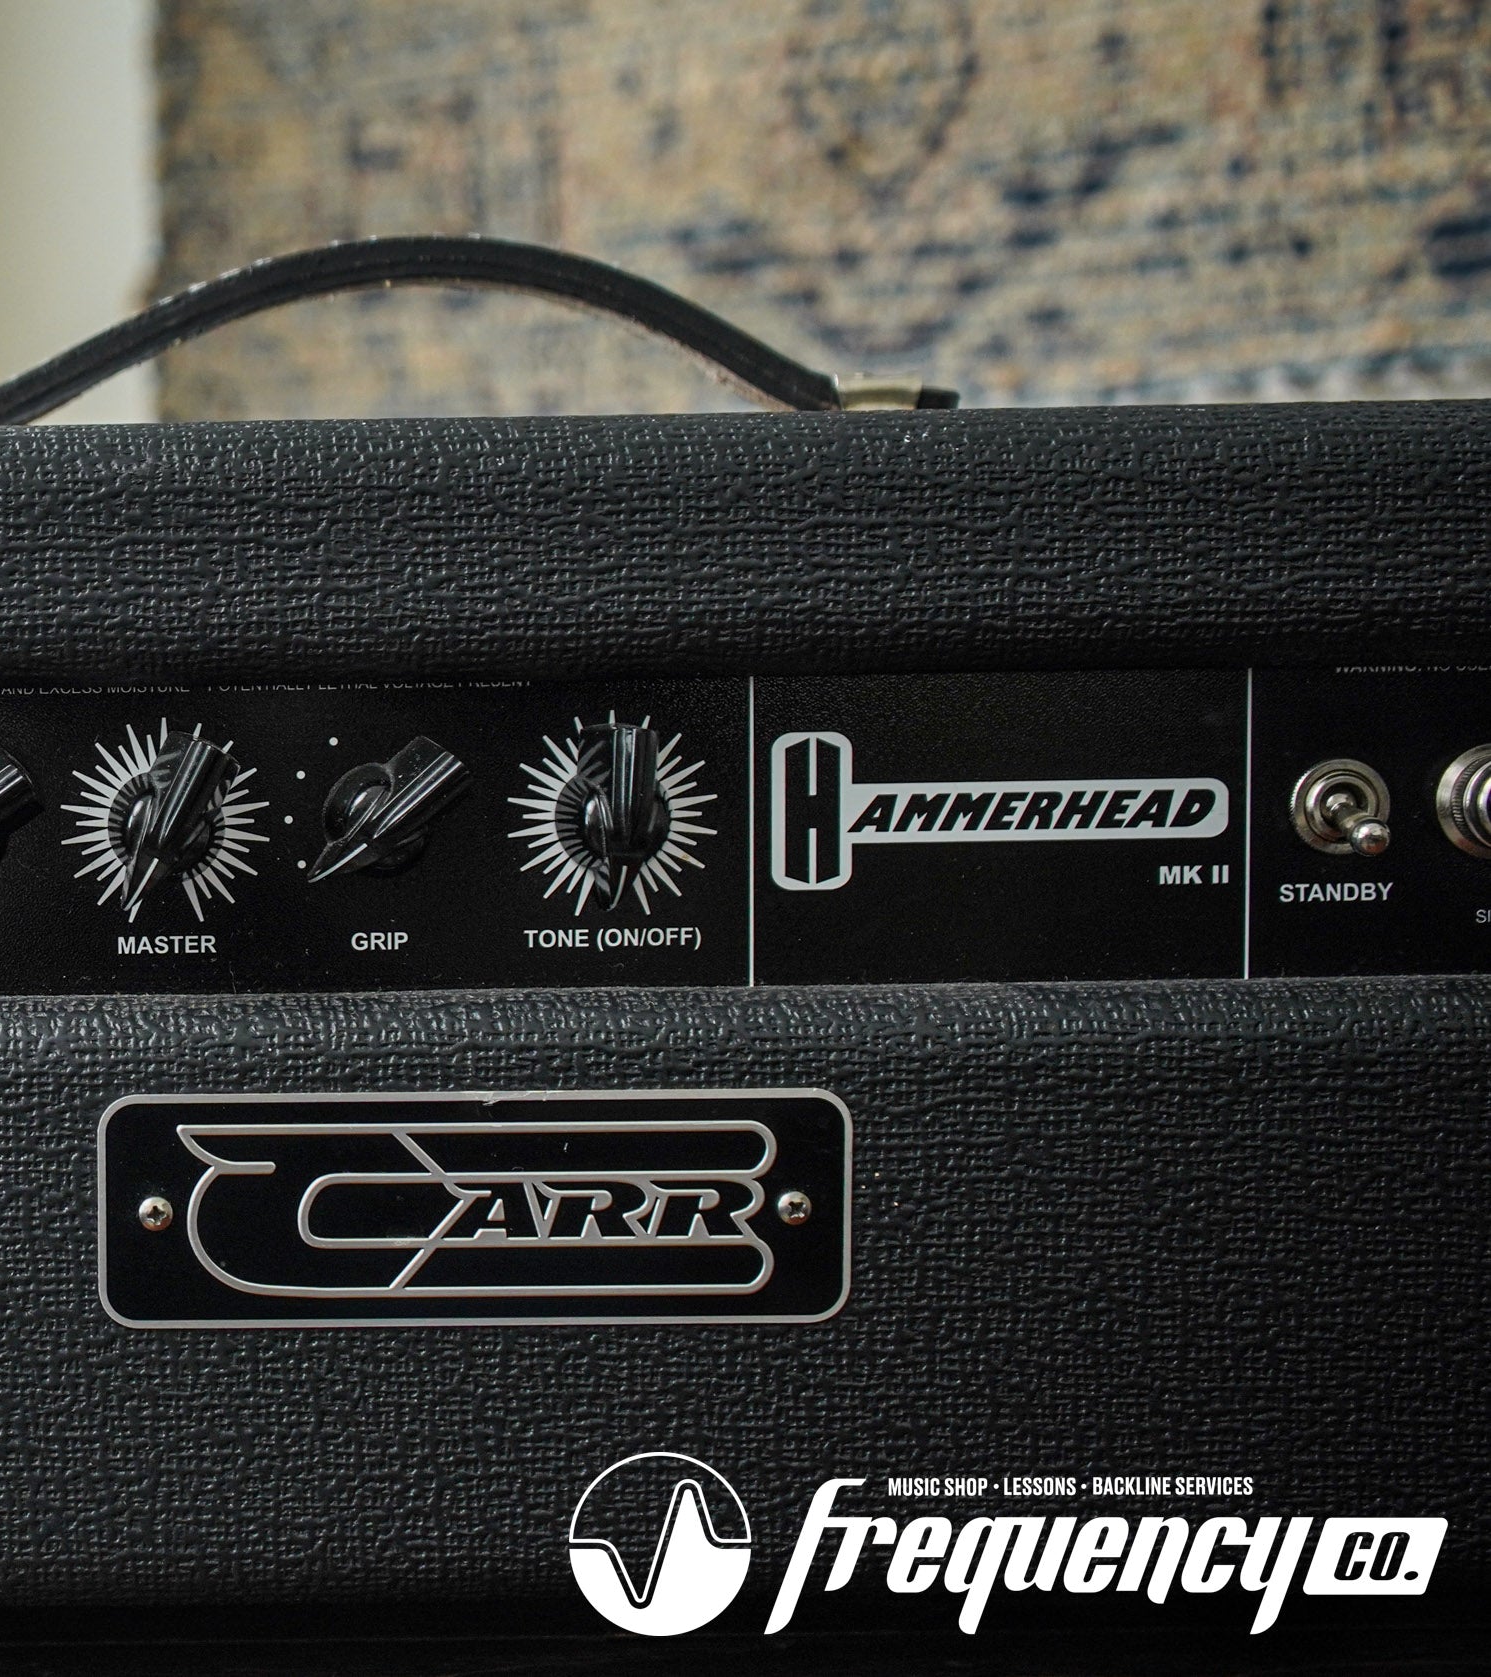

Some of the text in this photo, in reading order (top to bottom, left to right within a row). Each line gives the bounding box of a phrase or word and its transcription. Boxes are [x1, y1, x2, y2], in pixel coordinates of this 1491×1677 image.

[784, 737, 1217, 884] HAMMERHEAD
[1159, 864, 1229, 885] MK II
[1279, 882, 1394, 903] STANDBY
[117, 935, 217, 955] MASTER
[351, 931, 409, 951] GRIP
[524, 927, 702, 951] TONE (ON/OFF)
[177, 1120, 776, 1298] CARR
